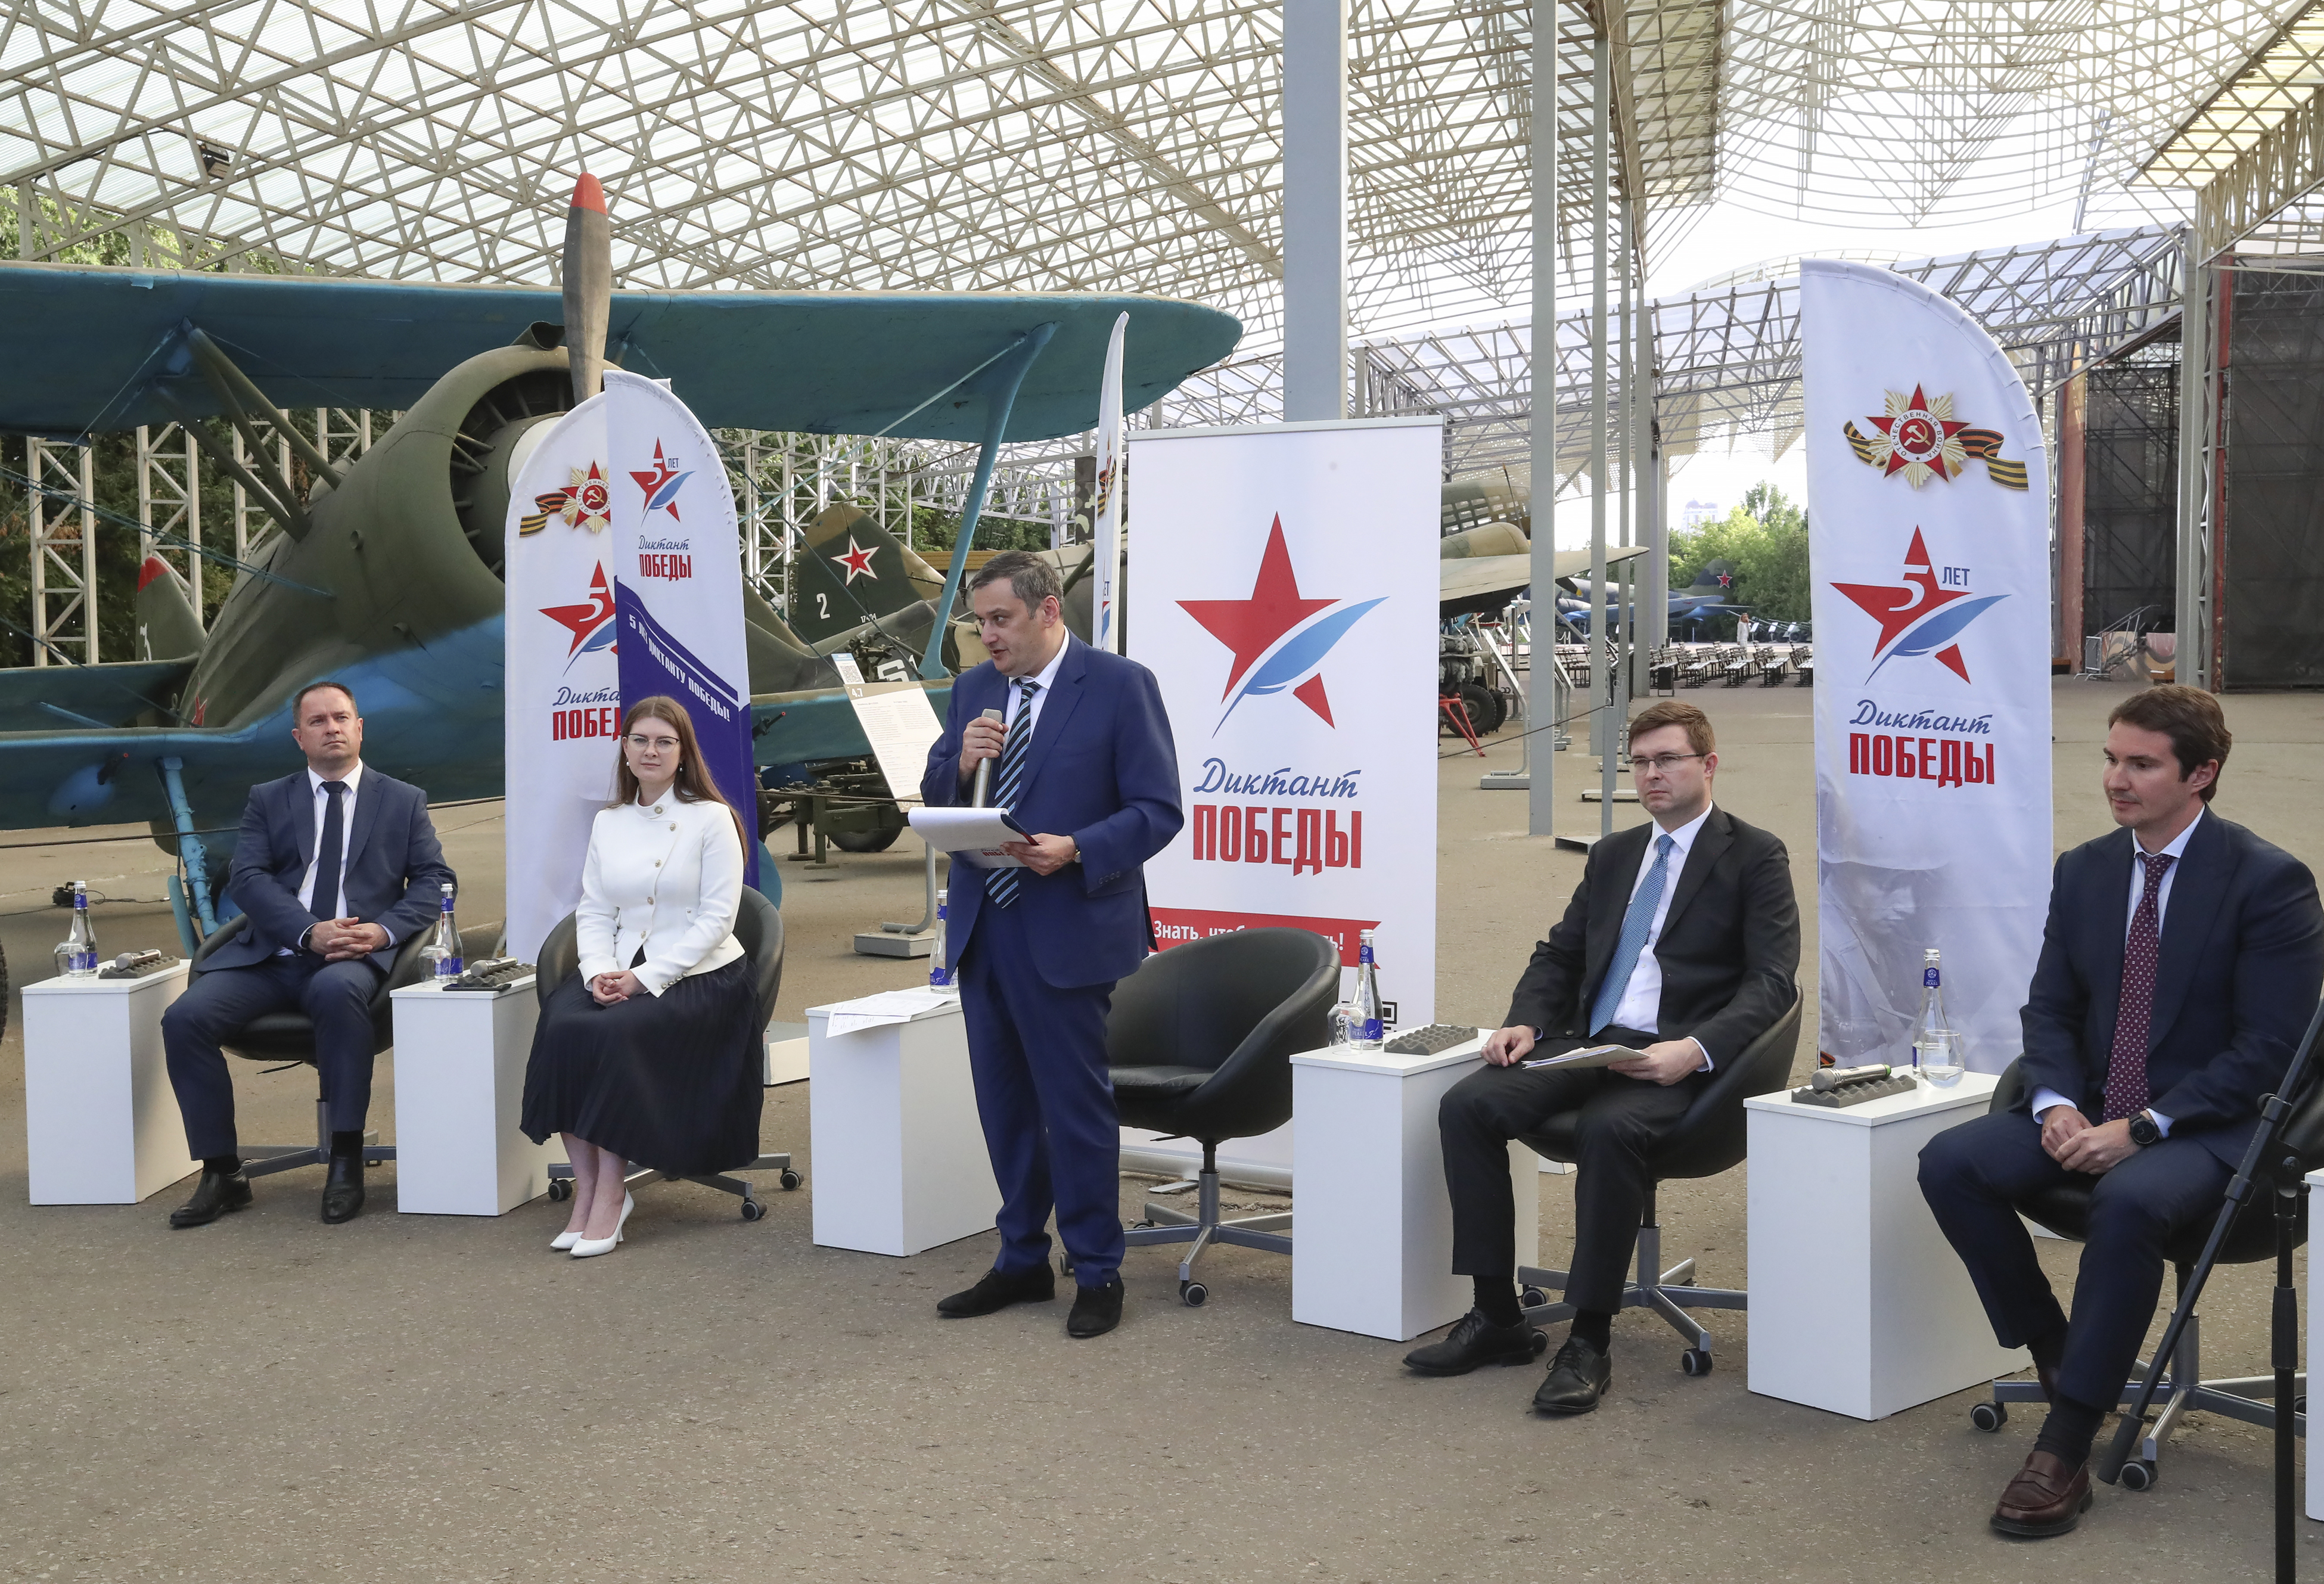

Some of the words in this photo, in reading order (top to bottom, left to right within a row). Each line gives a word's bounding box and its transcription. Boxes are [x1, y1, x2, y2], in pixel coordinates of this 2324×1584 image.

[1892, 412, 1938, 456] ОТЕЧЕСТВЕННАЯ
[647, 458, 663, 486] 5
[668, 458, 679, 468] ЛЕТ
[577, 480, 608, 513] ОТЕЧЕСТВЕННАЯ
[639, 535, 689, 550] Диктант
[639, 554, 691, 582] ПОБЕДЫ
[578, 586, 607, 622] 5
[1888, 565, 1930, 611] 5
[1942, 566, 1970, 586] ЛЕТ
[816, 593, 831, 620] 2
[629, 614, 636, 629] 5
[639, 621, 648, 644] ЛЕТ
[648, 637, 685, 684] ДИКТАНТУ
[688, 676, 731, 722] ПОБЕДЫ!
[552, 687, 620, 706] Дикта
[852, 688, 863, 697] 4.7
[1849, 700, 1993, 734] Диктант
[1850, 732, 1995, 788] ПОБЕДЫ
[1193, 757, 1362, 798] Диктант
[1193, 805, 1362, 877] ПОБЕДЫ
